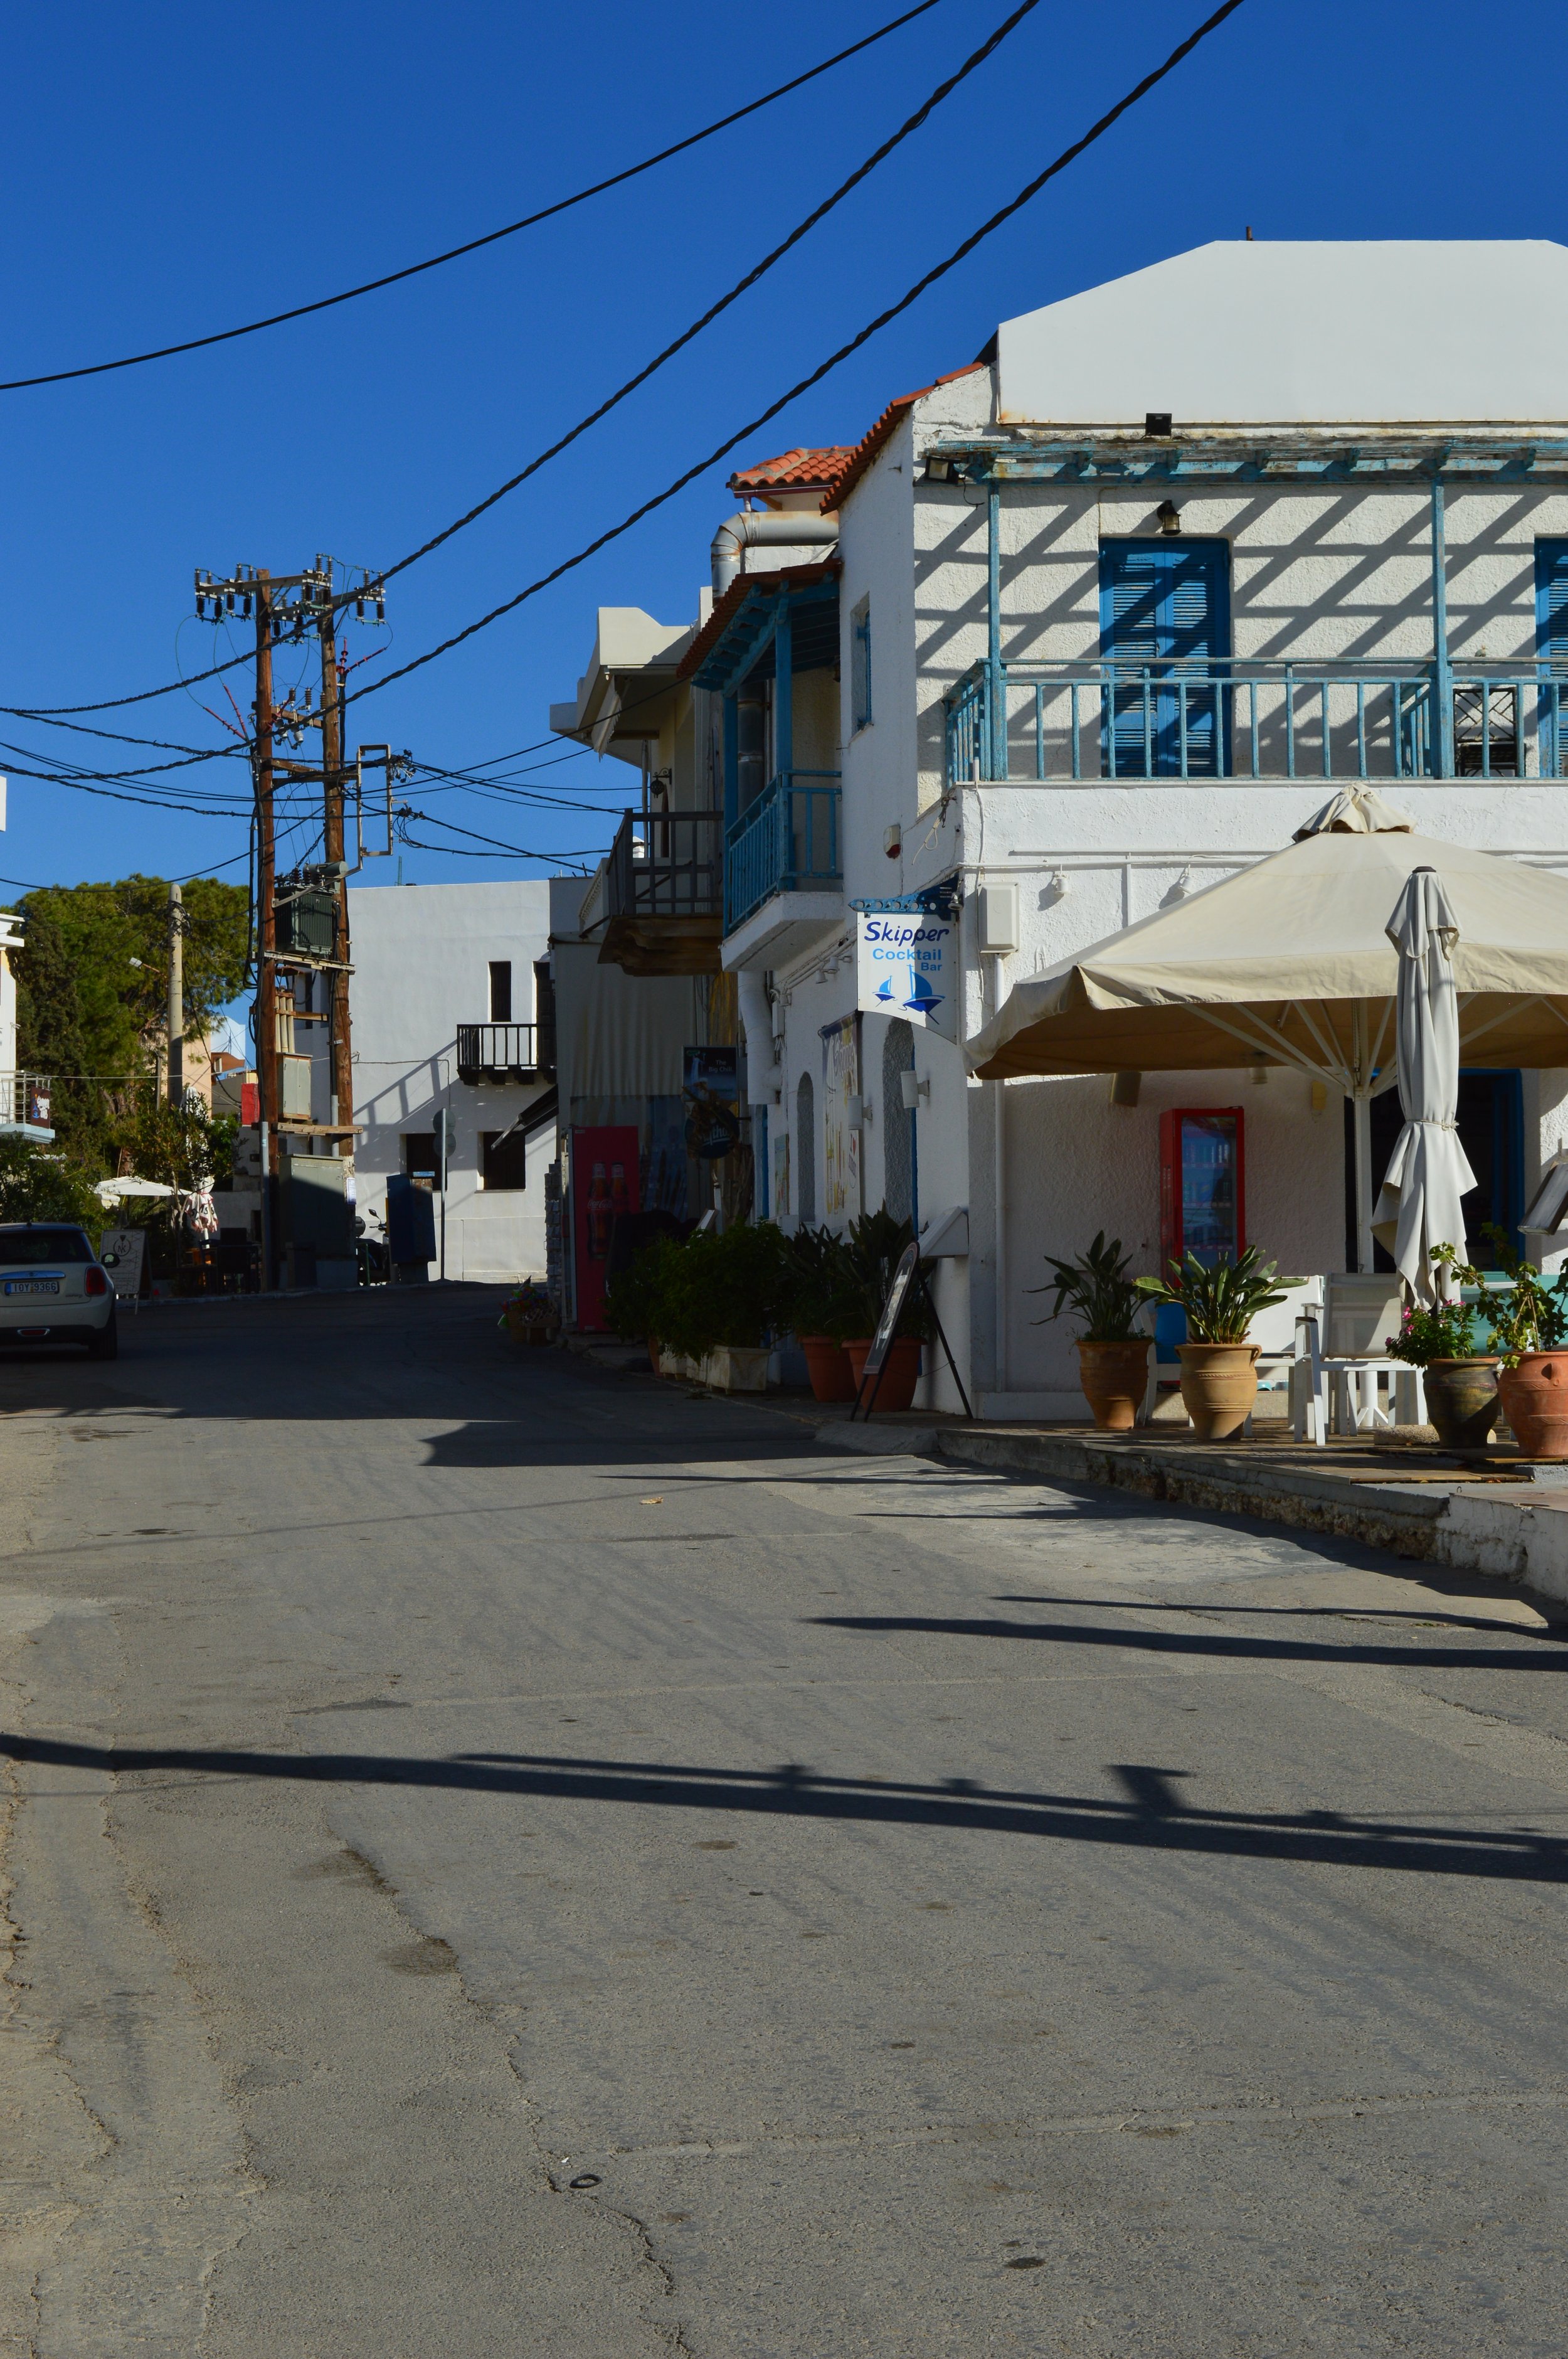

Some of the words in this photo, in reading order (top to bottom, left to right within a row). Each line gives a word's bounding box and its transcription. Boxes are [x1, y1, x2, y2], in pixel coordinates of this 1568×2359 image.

[864, 921, 950, 947] Skipper
[872, 948, 941, 961] Cocktail
[921, 962, 942, 971] Bar
